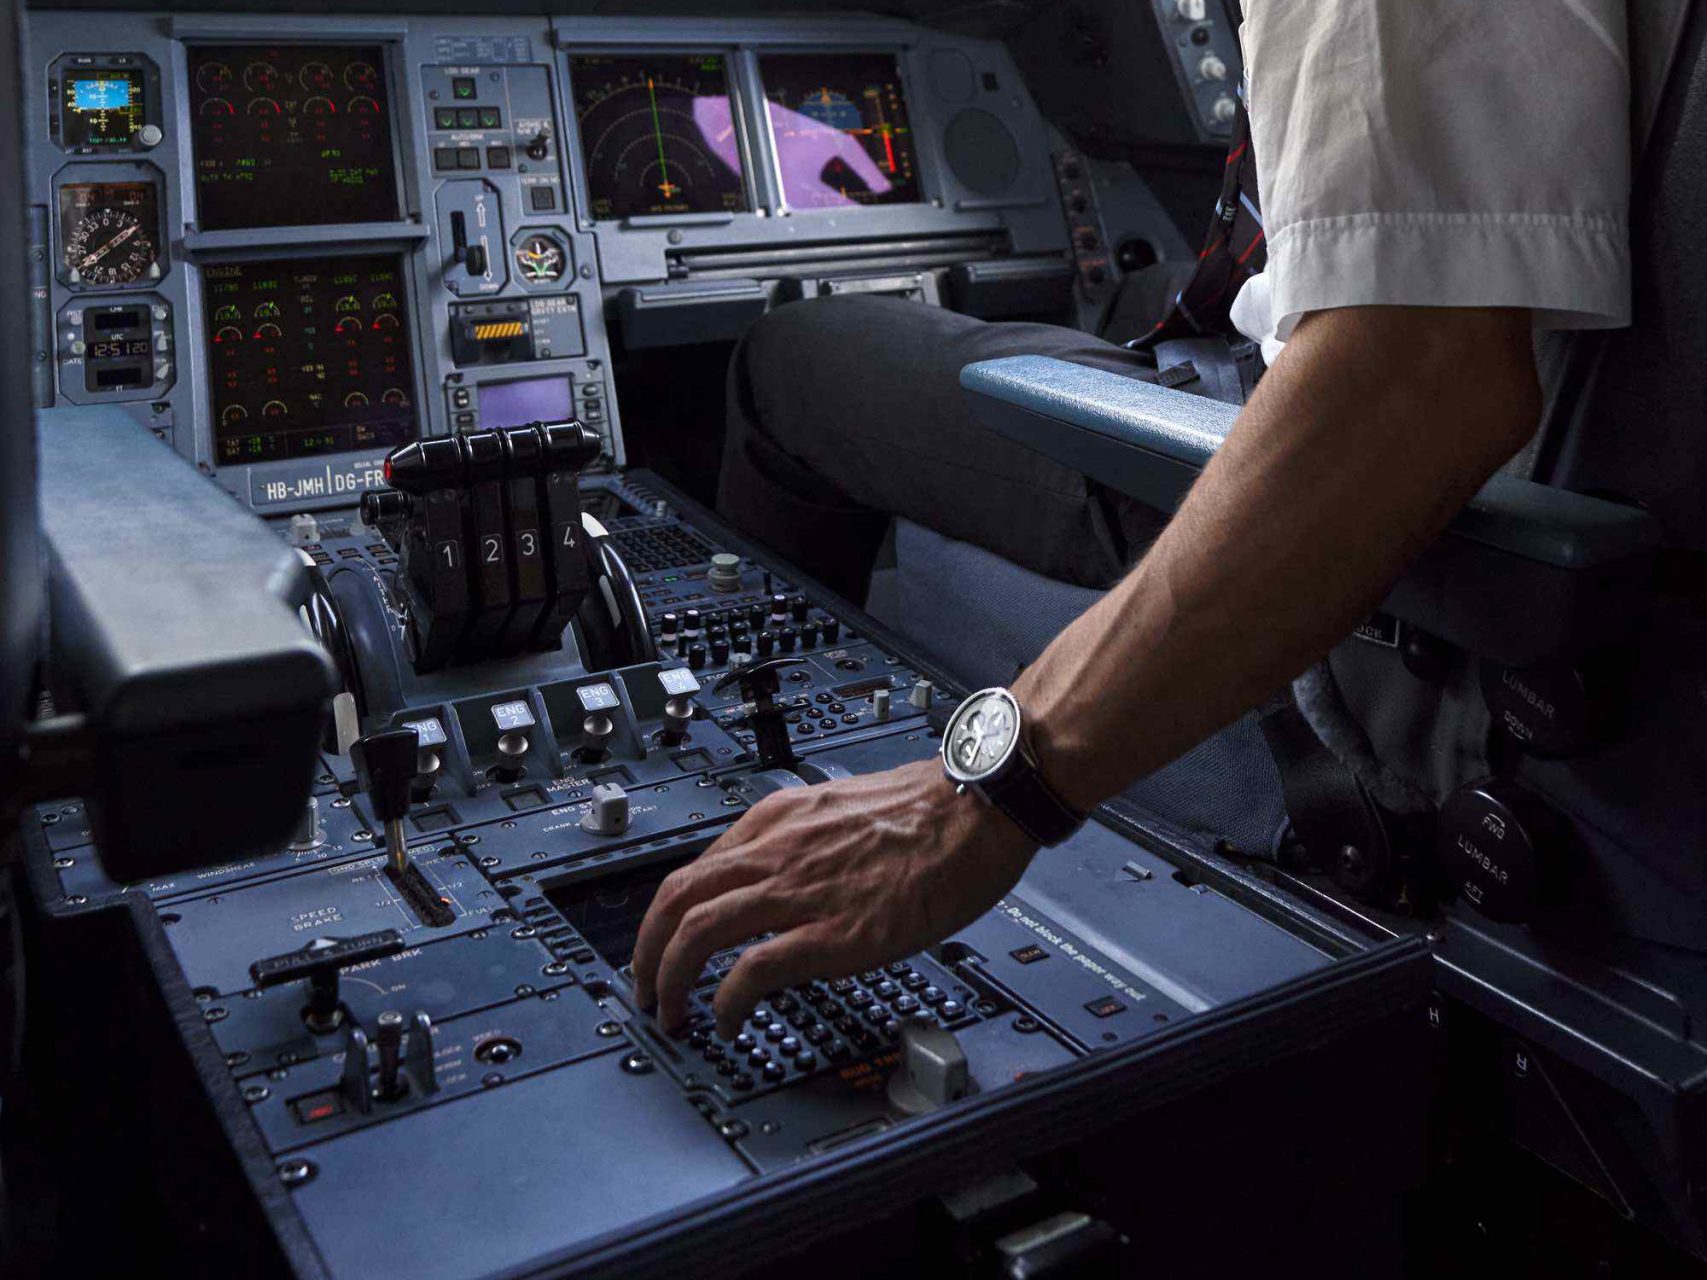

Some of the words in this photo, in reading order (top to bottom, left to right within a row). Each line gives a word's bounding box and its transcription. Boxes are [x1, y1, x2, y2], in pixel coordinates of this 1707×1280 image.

[267, 477, 324, 500] HB-JMH
[522, 533, 535, 556] 3
[563, 526, 576, 547] 4
[443, 546, 453, 567] 1
[485, 539, 499, 562] 2
[581, 686, 609, 697] ENG
[1501, 669, 1556, 720] LUMBAR
[496, 706, 525, 717] ENG
[595, 697, 604, 707] 3
[512, 715, 521, 726] 2
[546, 778, 590, 793] MASTER
[552, 776, 575, 786] ENG
[551, 805, 576, 816] ENG
[1482, 816, 1505, 840] FWD
[1457, 833, 1508, 885] LUMBAR
[290, 906, 337, 923] SPEED
[294, 913, 344, 931] BRAKE
[340, 959, 381, 975] PARK
[392, 948, 423, 963] BRK
